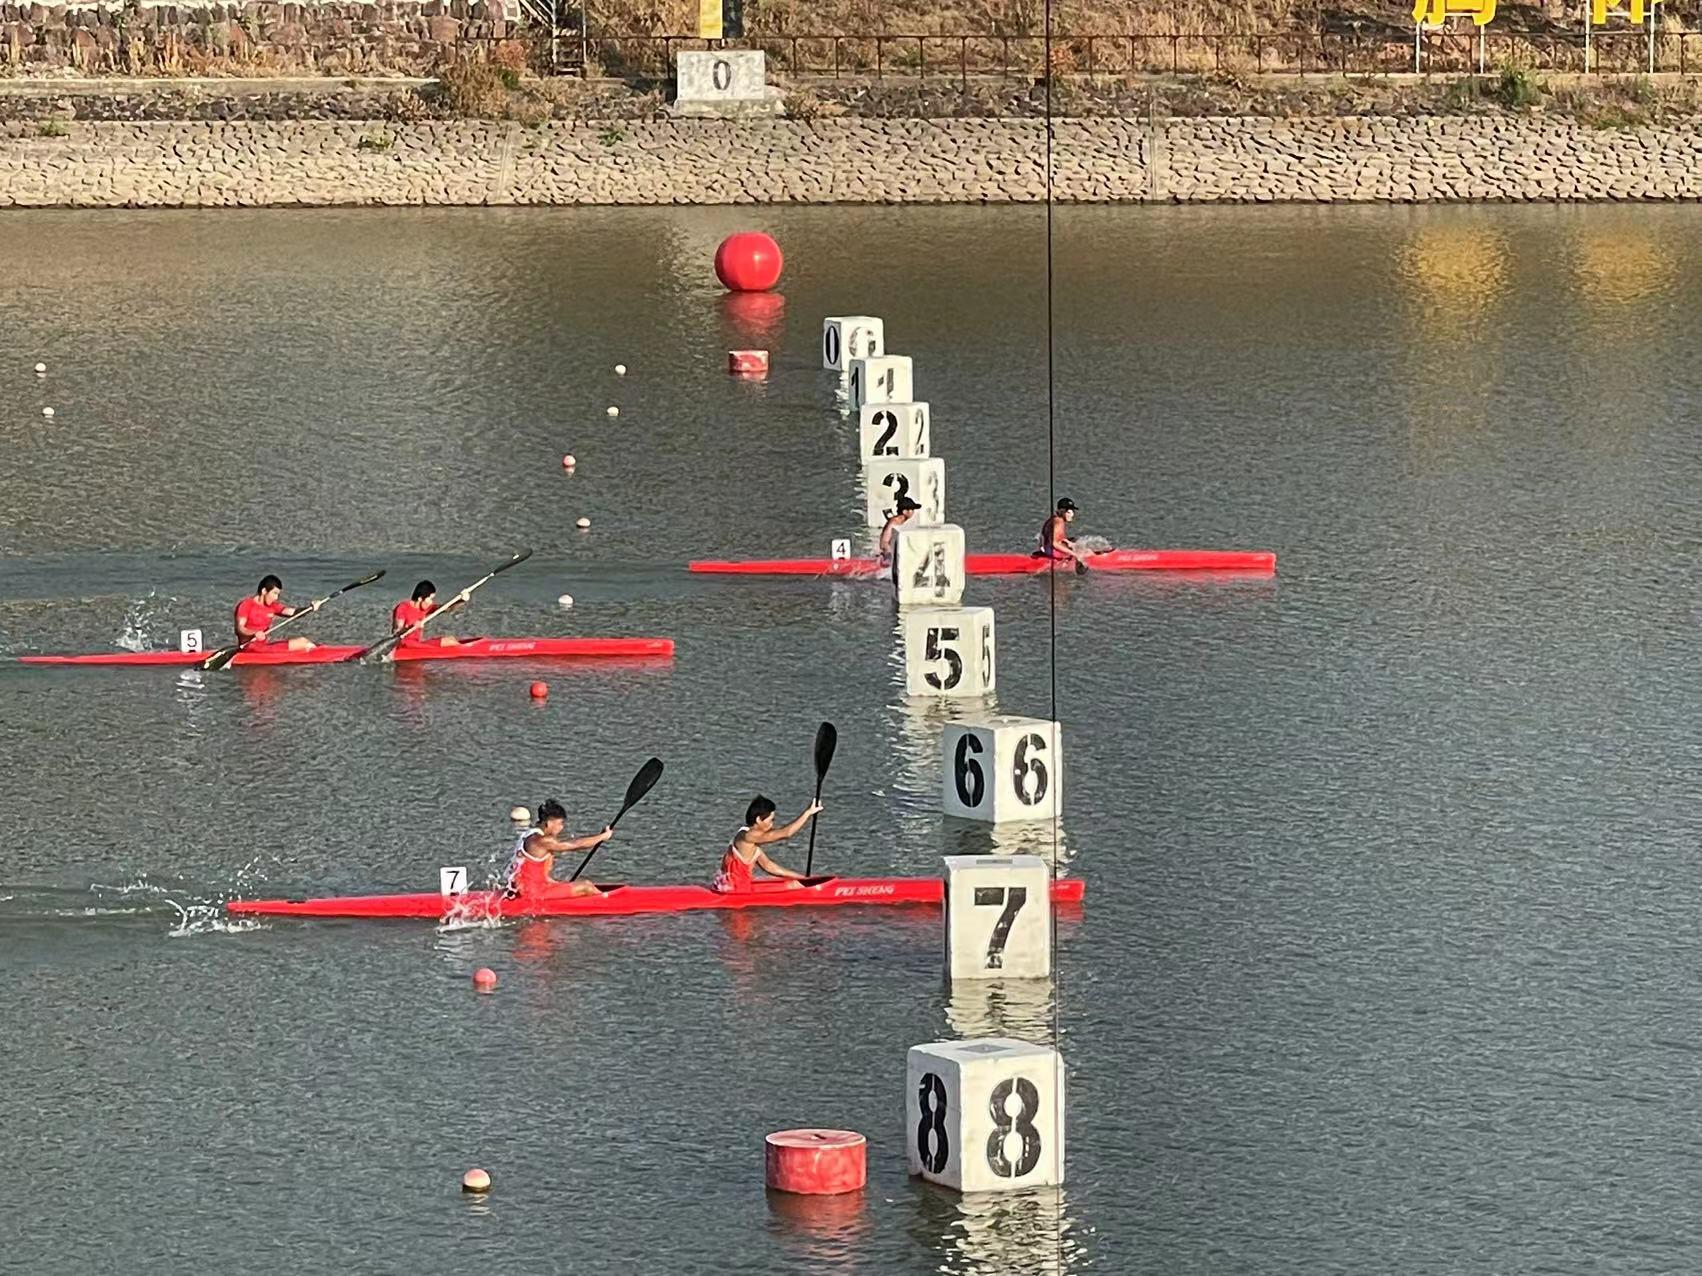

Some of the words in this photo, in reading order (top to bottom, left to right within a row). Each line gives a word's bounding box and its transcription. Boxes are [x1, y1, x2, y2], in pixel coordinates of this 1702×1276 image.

[712, 60, 732, 91] 0
[825, 325, 840, 365] 0
[850, 366, 860, 408] 1
[871, 410, 899, 456] 2
[915, 408, 925, 455] 2
[836, 542, 846, 555] 4
[912, 541, 951, 598] 4
[187, 632, 198, 648] 5
[924, 627, 963, 690] 5
[981, 623, 991, 687] 5
[954, 733, 985, 807] 6
[1013, 733, 1048, 806] 6
[446, 870, 460, 890] 7
[974, 887, 1027, 969] 7
[917, 1072, 949, 1174] 8
[986, 1076, 1042, 1178] 8
